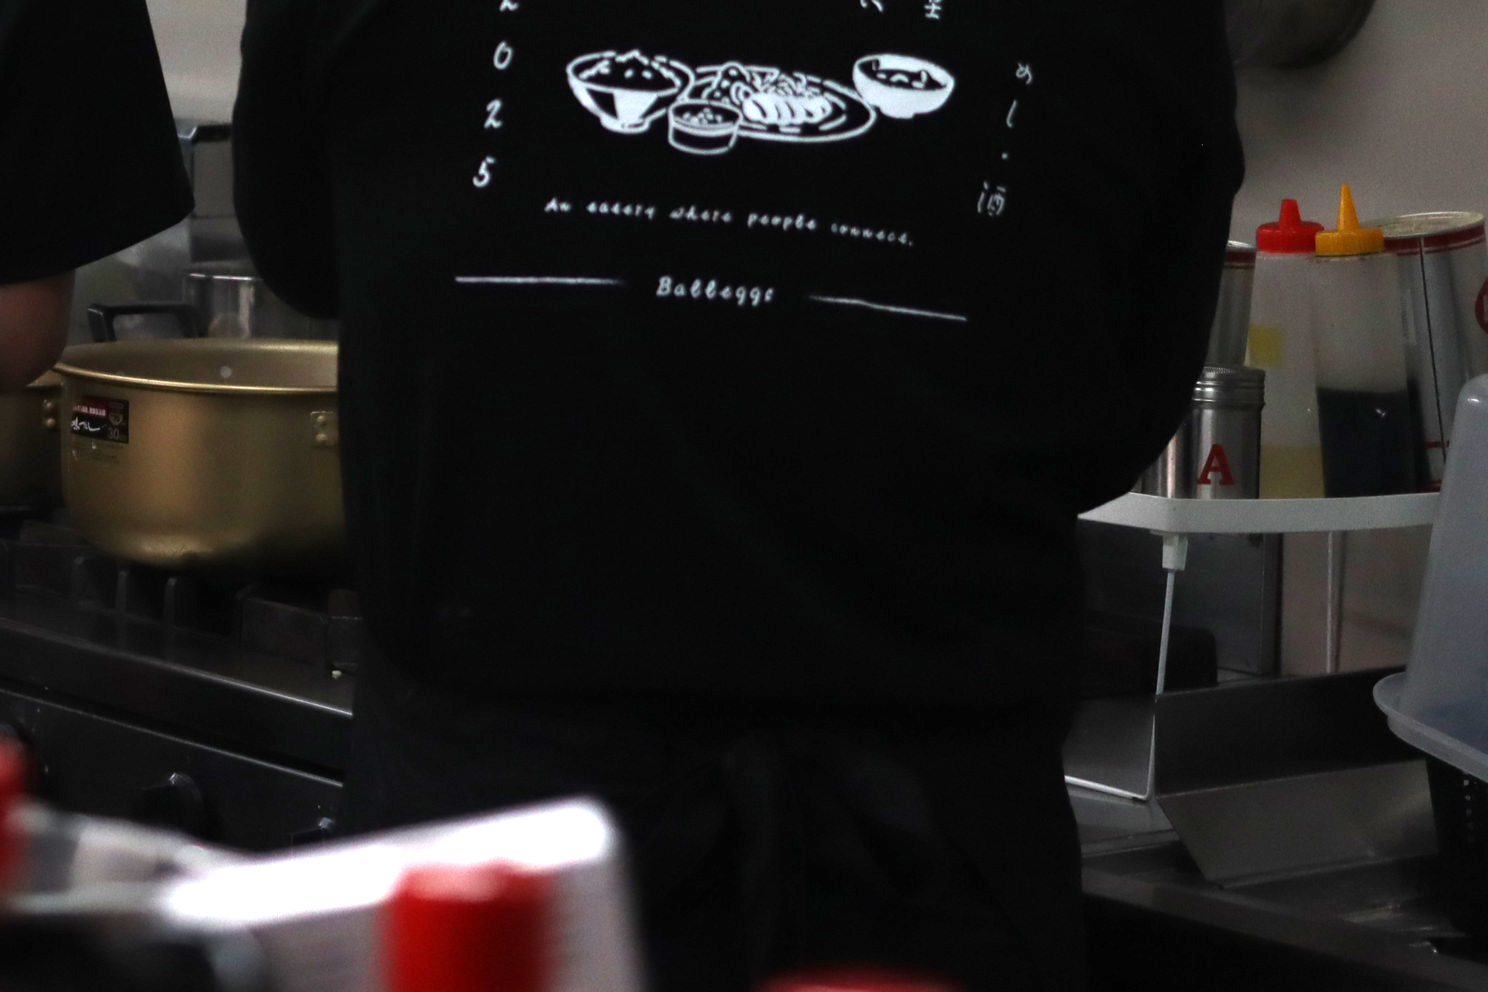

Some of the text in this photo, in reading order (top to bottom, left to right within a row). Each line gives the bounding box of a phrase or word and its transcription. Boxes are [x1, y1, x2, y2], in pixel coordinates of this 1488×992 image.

[543, 196, 572, 213] An
[669, 204, 733, 223] where
[746, 211, 817, 231] people
[1197, 443, 1235, 485] A
